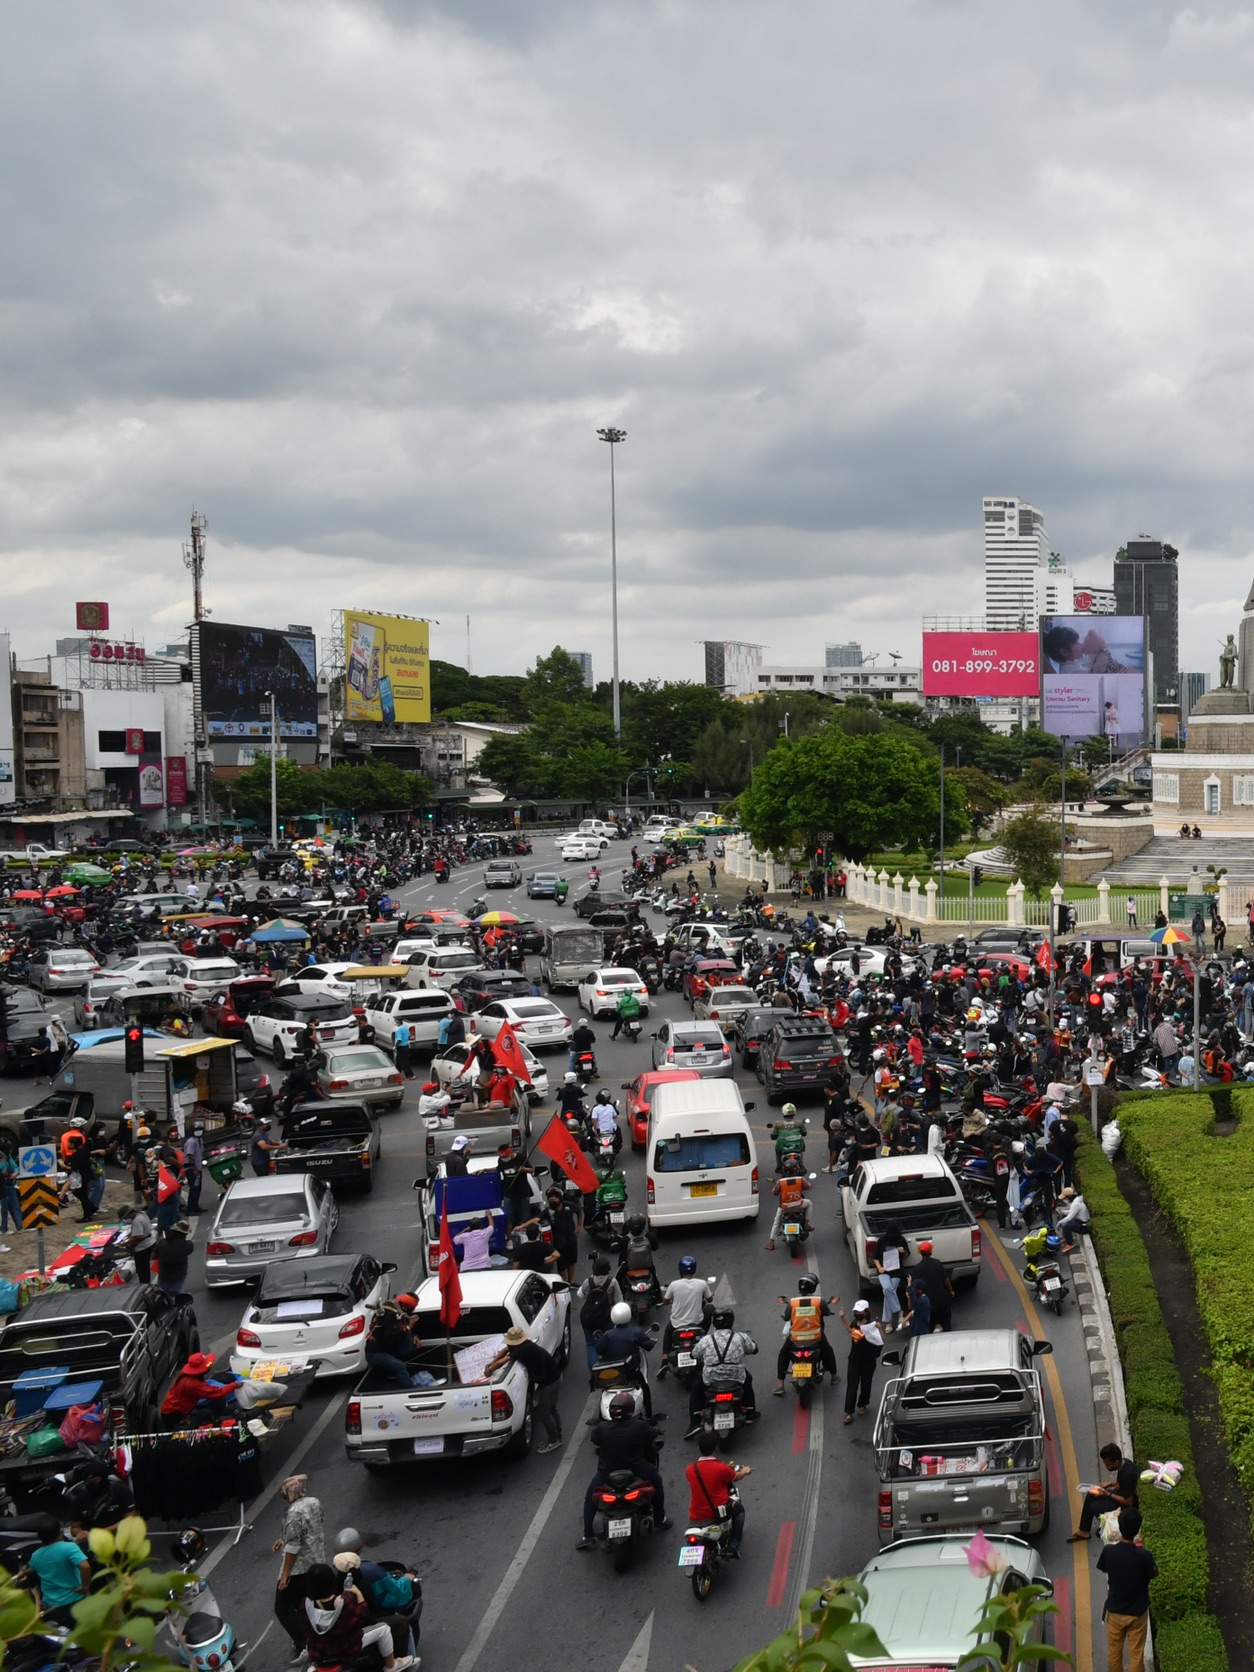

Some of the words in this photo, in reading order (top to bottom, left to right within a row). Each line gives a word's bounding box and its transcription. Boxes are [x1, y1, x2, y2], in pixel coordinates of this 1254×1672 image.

[971, 647, 998, 656] โฆษณา
[932, 660, 1035, 673] 081-899-3792
[1054, 687, 1073, 695] styler
[306, 1158, 333, 1167] ISUZU
